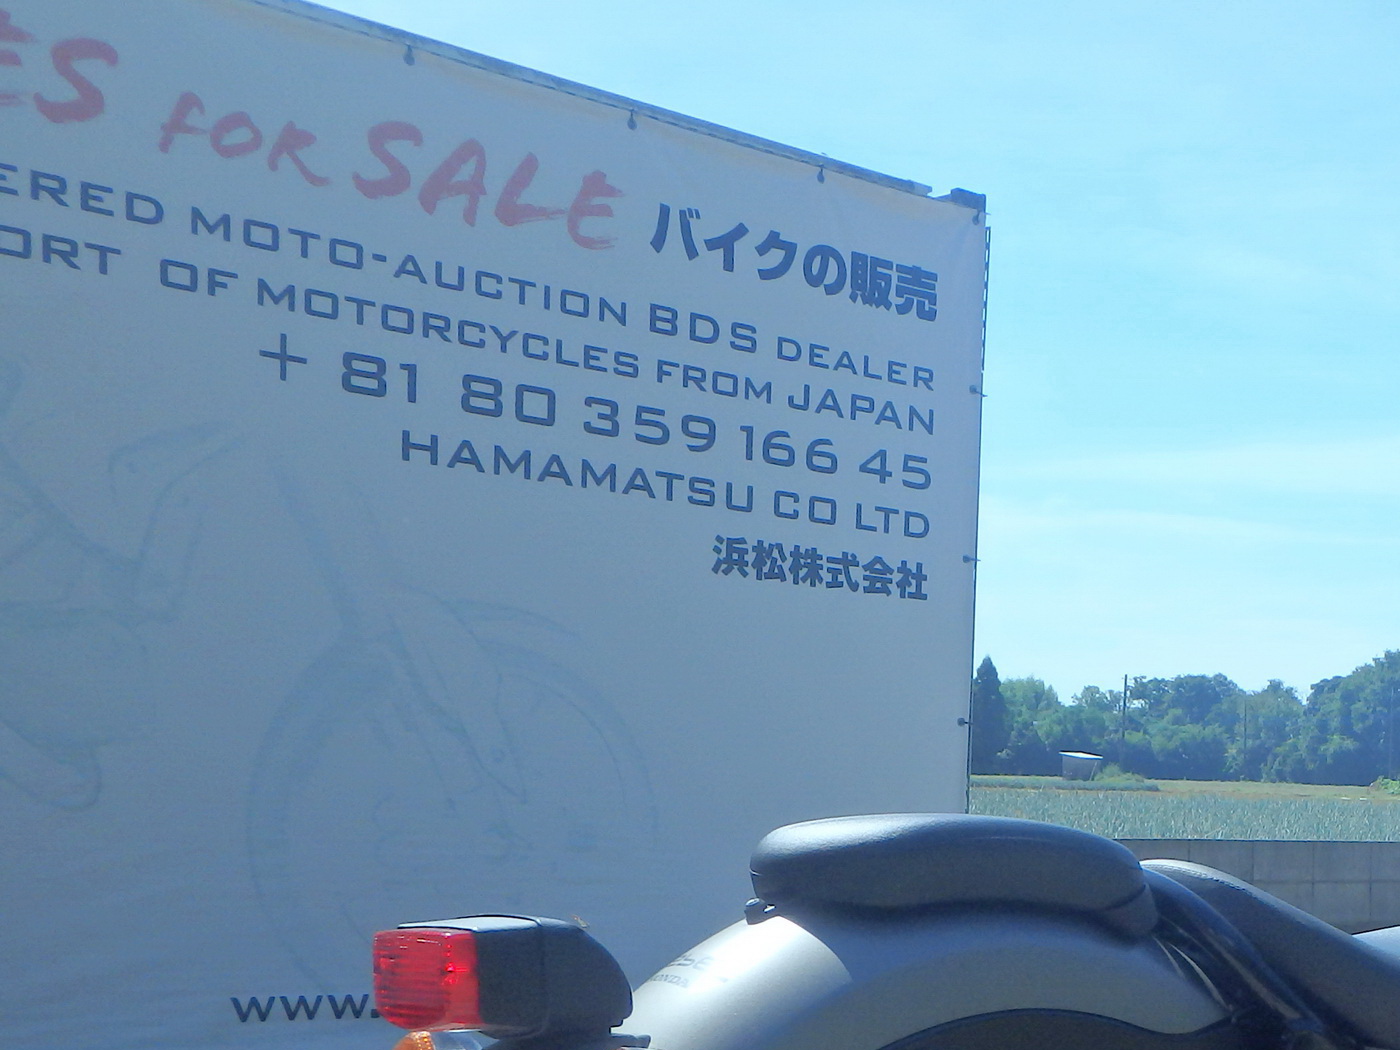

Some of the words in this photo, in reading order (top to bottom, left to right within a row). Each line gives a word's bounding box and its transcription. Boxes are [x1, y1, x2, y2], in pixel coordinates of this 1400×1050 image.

[352, 120, 623, 250] SALE
[191, 206, 627, 327] MOTO-AUCTION
[648, 303, 758, 354] BDS
[776, 335, 934, 392] DEALER
[650, 202, 939, 323] バイクの販売
[0, 224, 122, 276] ORT
[159, 259, 239, 297] OF
[257, 278, 640, 379] MOTORCYCLES
[656, 359, 773, 405] FROM
[788, 384, 934, 436] JAPAN
[341, 352, 418, 404] 81
[461, 373, 557, 427] 80
[583, 396, 717, 453] 359
[739, 426, 838, 475] 166
[858, 449, 932, 491] 45
[402, 430, 754, 513] HAMAMATSU
[773, 490, 838, 526] CO
[856, 503, 930, 539] LTD
[712, 534, 929, 601] 浜松株式会社
